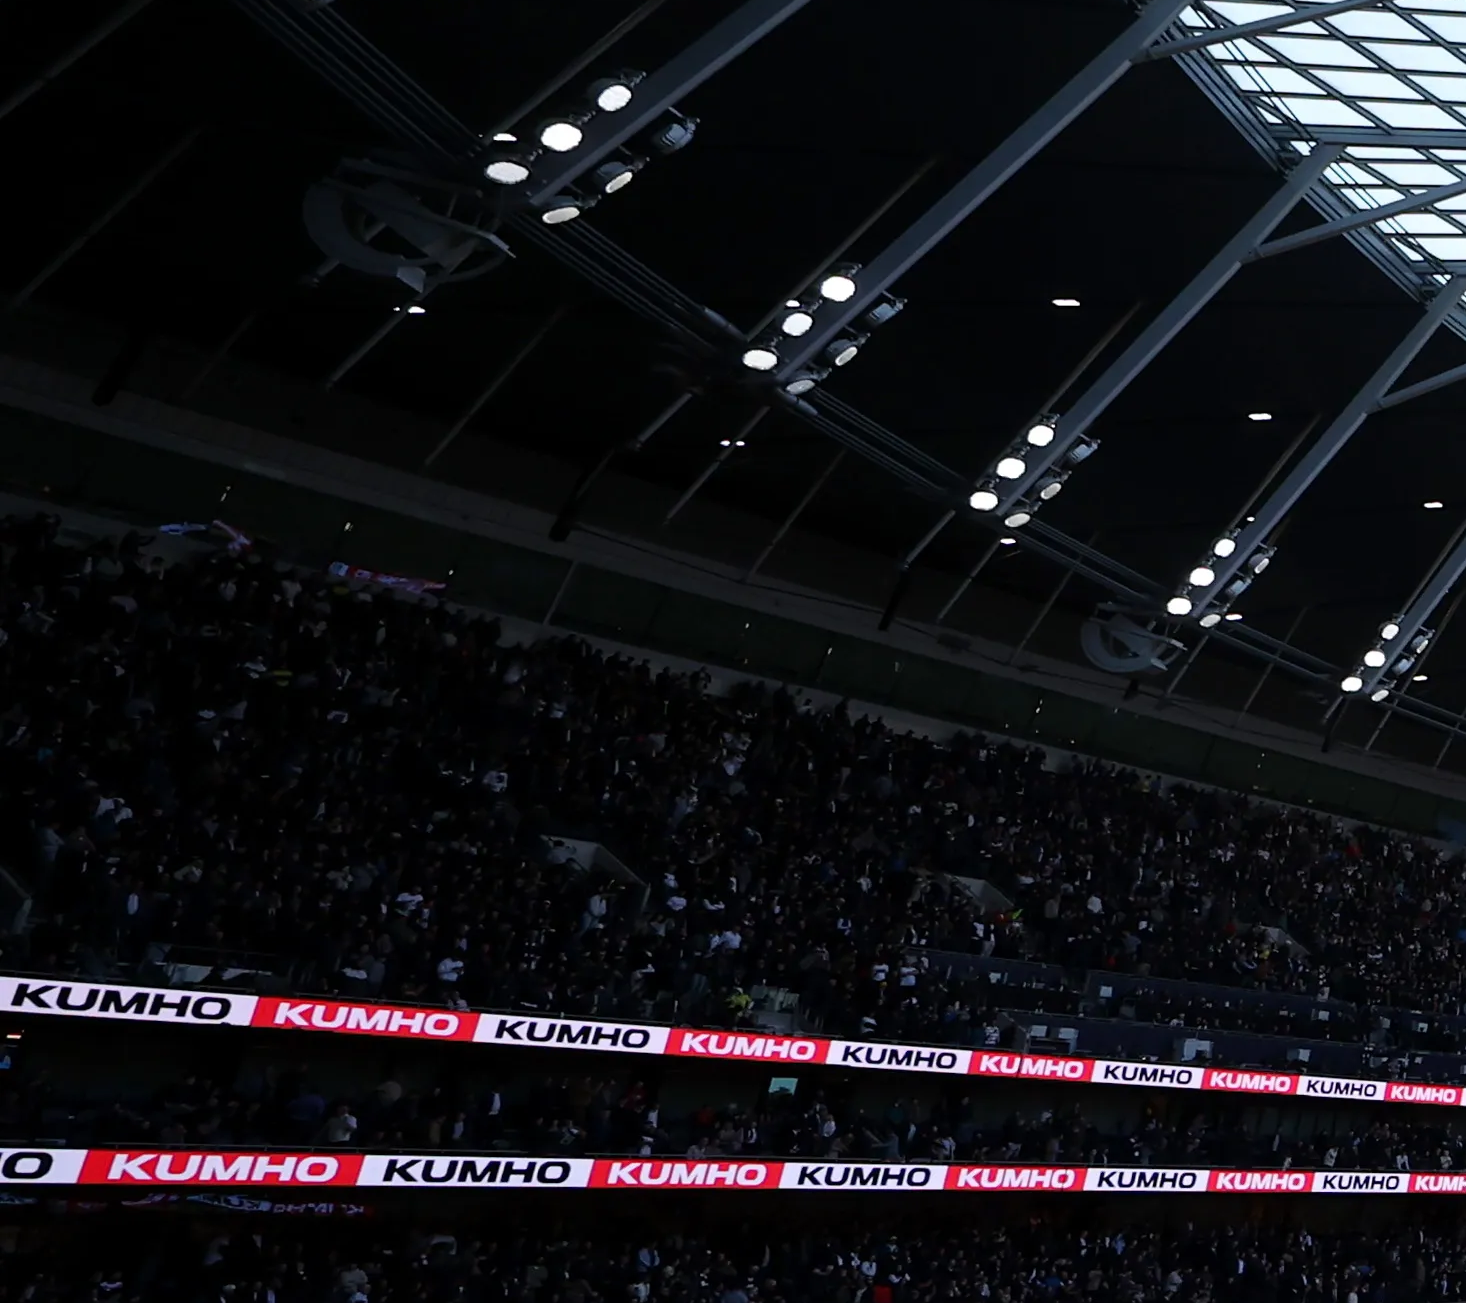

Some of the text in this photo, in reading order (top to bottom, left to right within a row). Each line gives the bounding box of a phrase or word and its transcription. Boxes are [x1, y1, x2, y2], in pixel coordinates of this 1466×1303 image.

[11, 982, 232, 1021] KUMHO
[274, 1001, 459, 1038] KUMHO
[495, 1019, 650, 1049] KUMHO
[681, 1031, 816, 1061] KUMHO
[842, 1045, 957, 1070] KUMHO
[980, 1053, 1084, 1079] KUMHO
[1104, 1064, 1192, 1085] KUMHO
[1210, 1071, 1291, 1093] KUMHO
[1306, 1079, 1377, 1098] KUMHO
[1391, 1084, 1456, 1104] KUMHO
[108, 1154, 339, 1182] KUMHO
[383, 1158, 571, 1184] KUMHO
[607, 1162, 767, 1186] KUMHO
[797, 1165, 931, 1187] KUMHO
[957, 1168, 1075, 1189] KUMHO
[1097, 1171, 1197, 1189] KUMHO
[1216, 1172, 1306, 1190] KUMHO
[1323, 1175, 1400, 1190] KUMHO
